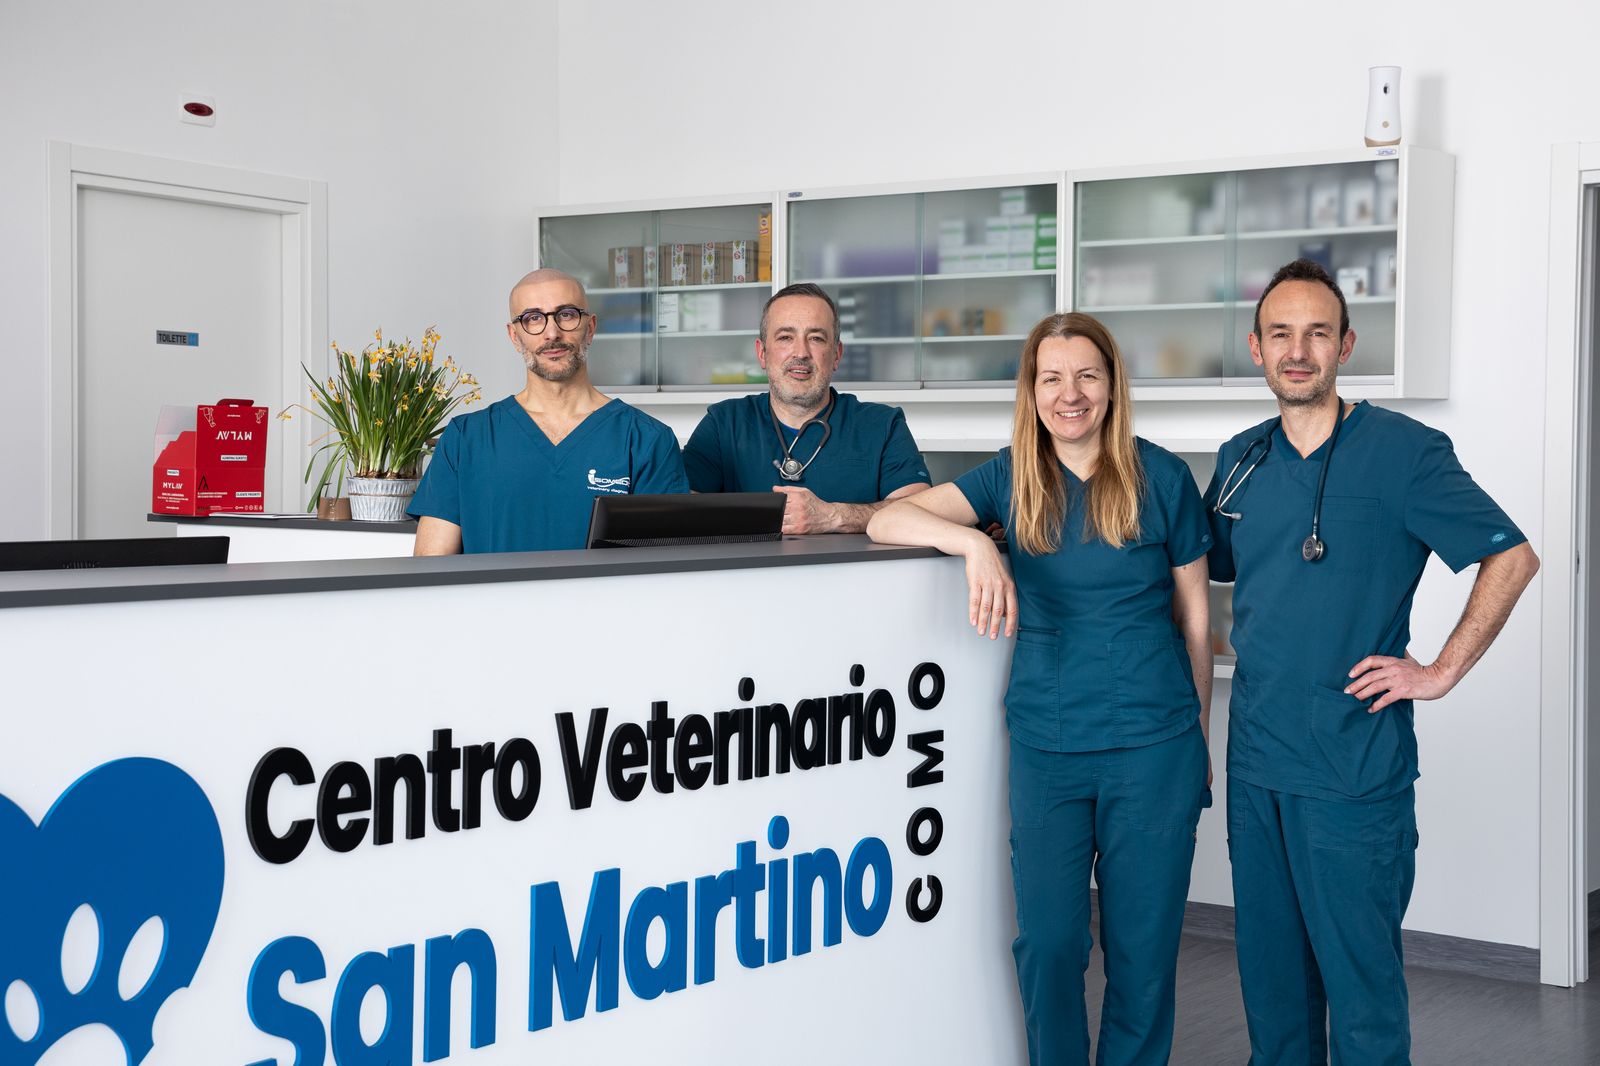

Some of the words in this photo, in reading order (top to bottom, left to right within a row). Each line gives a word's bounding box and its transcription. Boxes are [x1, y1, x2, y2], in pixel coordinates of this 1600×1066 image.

[158, 333, 187, 344] TOILETTE
[162, 481, 183, 489] MYLAV
[216, 431, 252, 441] MYLAV
[245, 728, 541, 865] Centro
[555, 663, 896, 811] Veterinario
[905, 661, 946, 923] COMO
[244, 927, 497, 1066] San
[528, 815, 893, 1032] Martino
